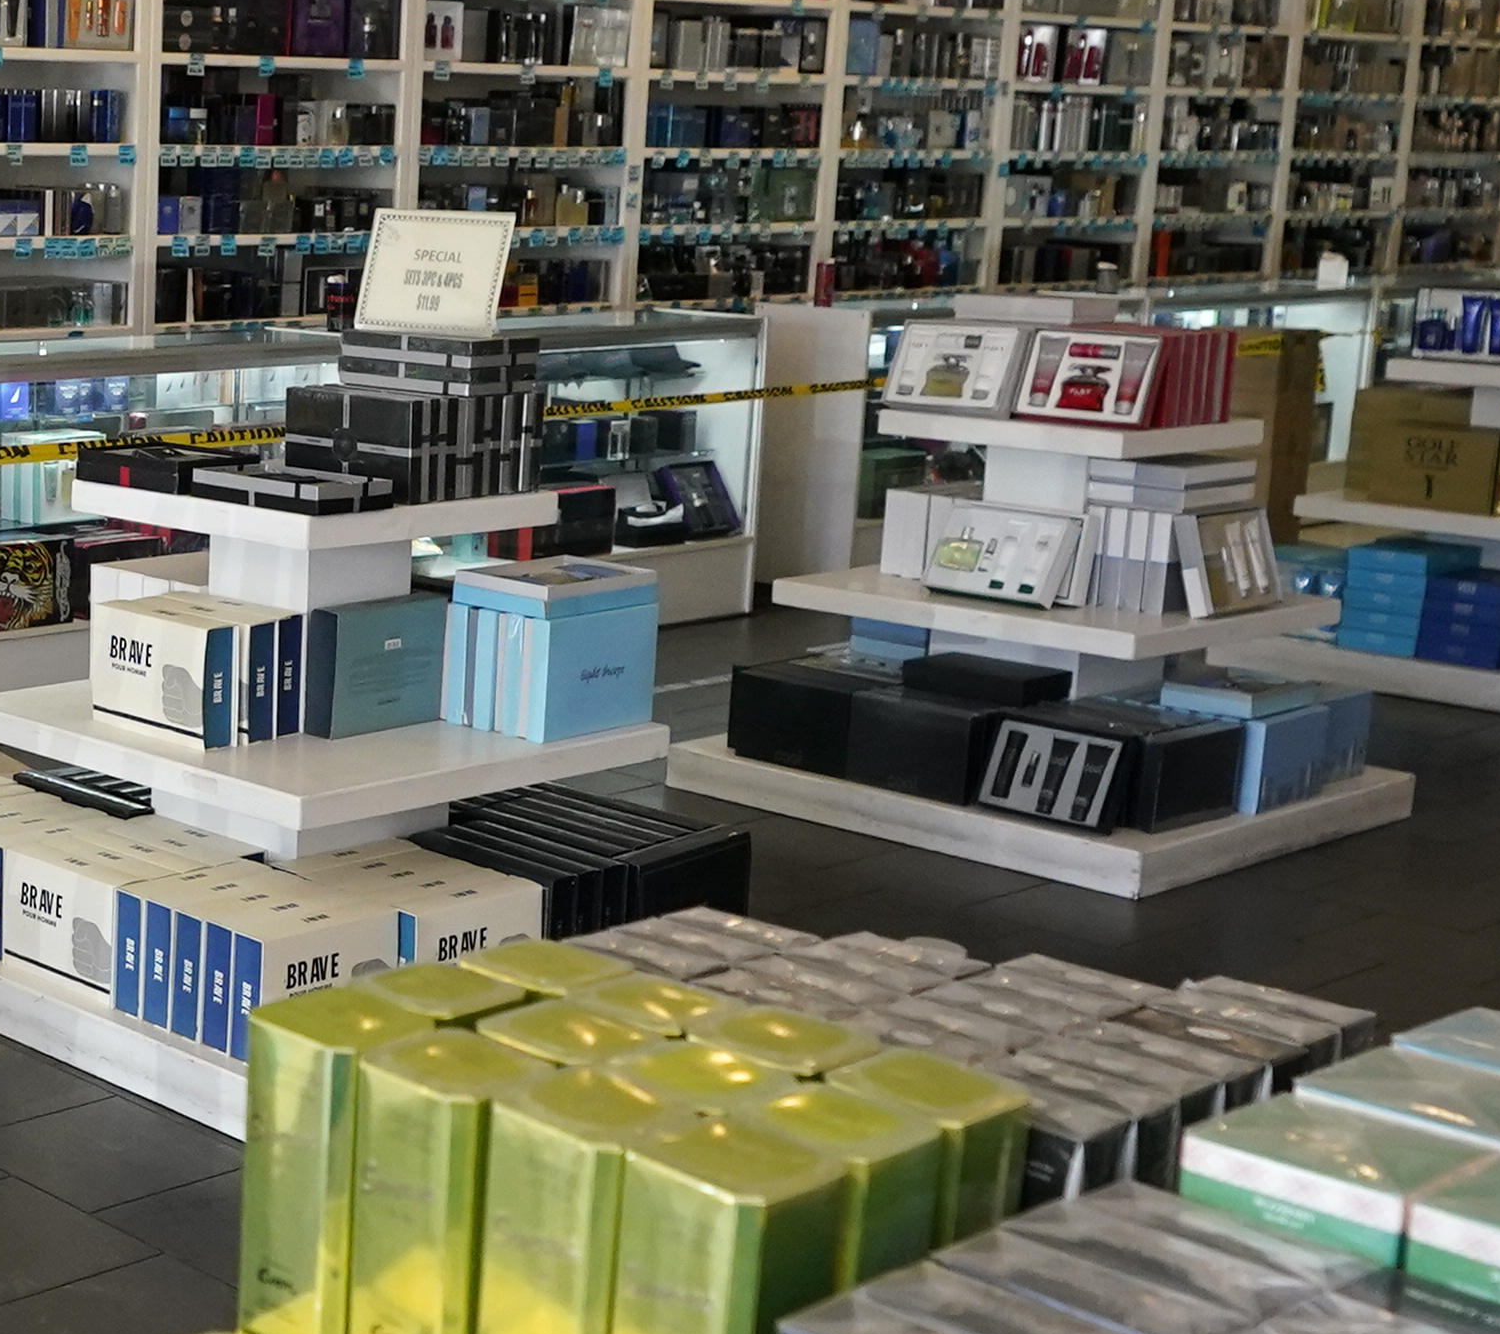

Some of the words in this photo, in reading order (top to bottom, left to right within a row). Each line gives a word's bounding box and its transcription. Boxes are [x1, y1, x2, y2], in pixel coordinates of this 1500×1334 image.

[414, 249, 463, 264] SPECIAL
[110, 635, 153, 667] BRAVE
[21, 881, 63, 919] BRAVE
[286, 953, 339, 990] BRAVE
